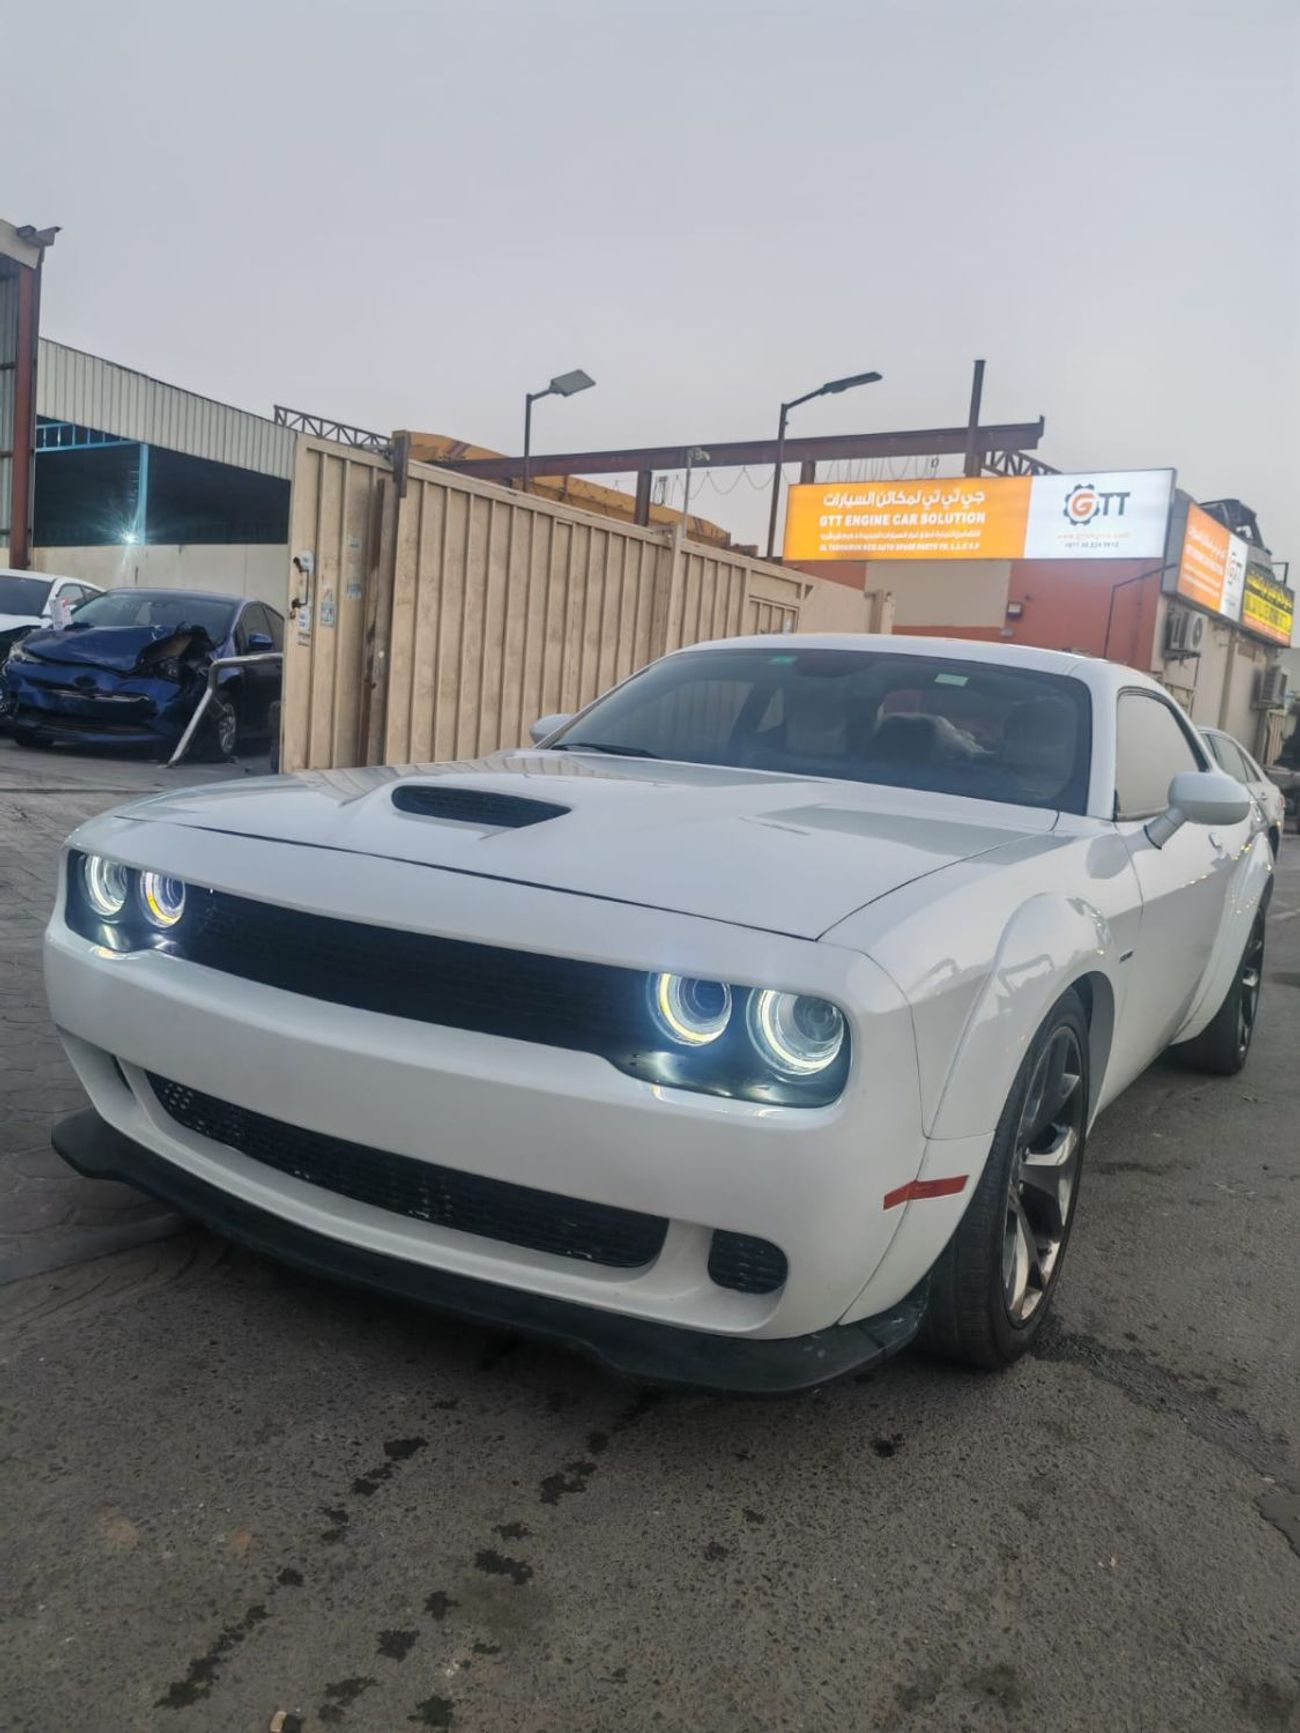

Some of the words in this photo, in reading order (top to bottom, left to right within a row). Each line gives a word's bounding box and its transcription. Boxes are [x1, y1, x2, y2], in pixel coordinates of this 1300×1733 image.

[1071, 491, 1131, 517] GTT
[819, 514, 843, 527] GTT
[844, 514, 891, 527] ENGINE
[892, 513, 919, 526] CAR
[920, 511, 987, 525] SOLUTION
